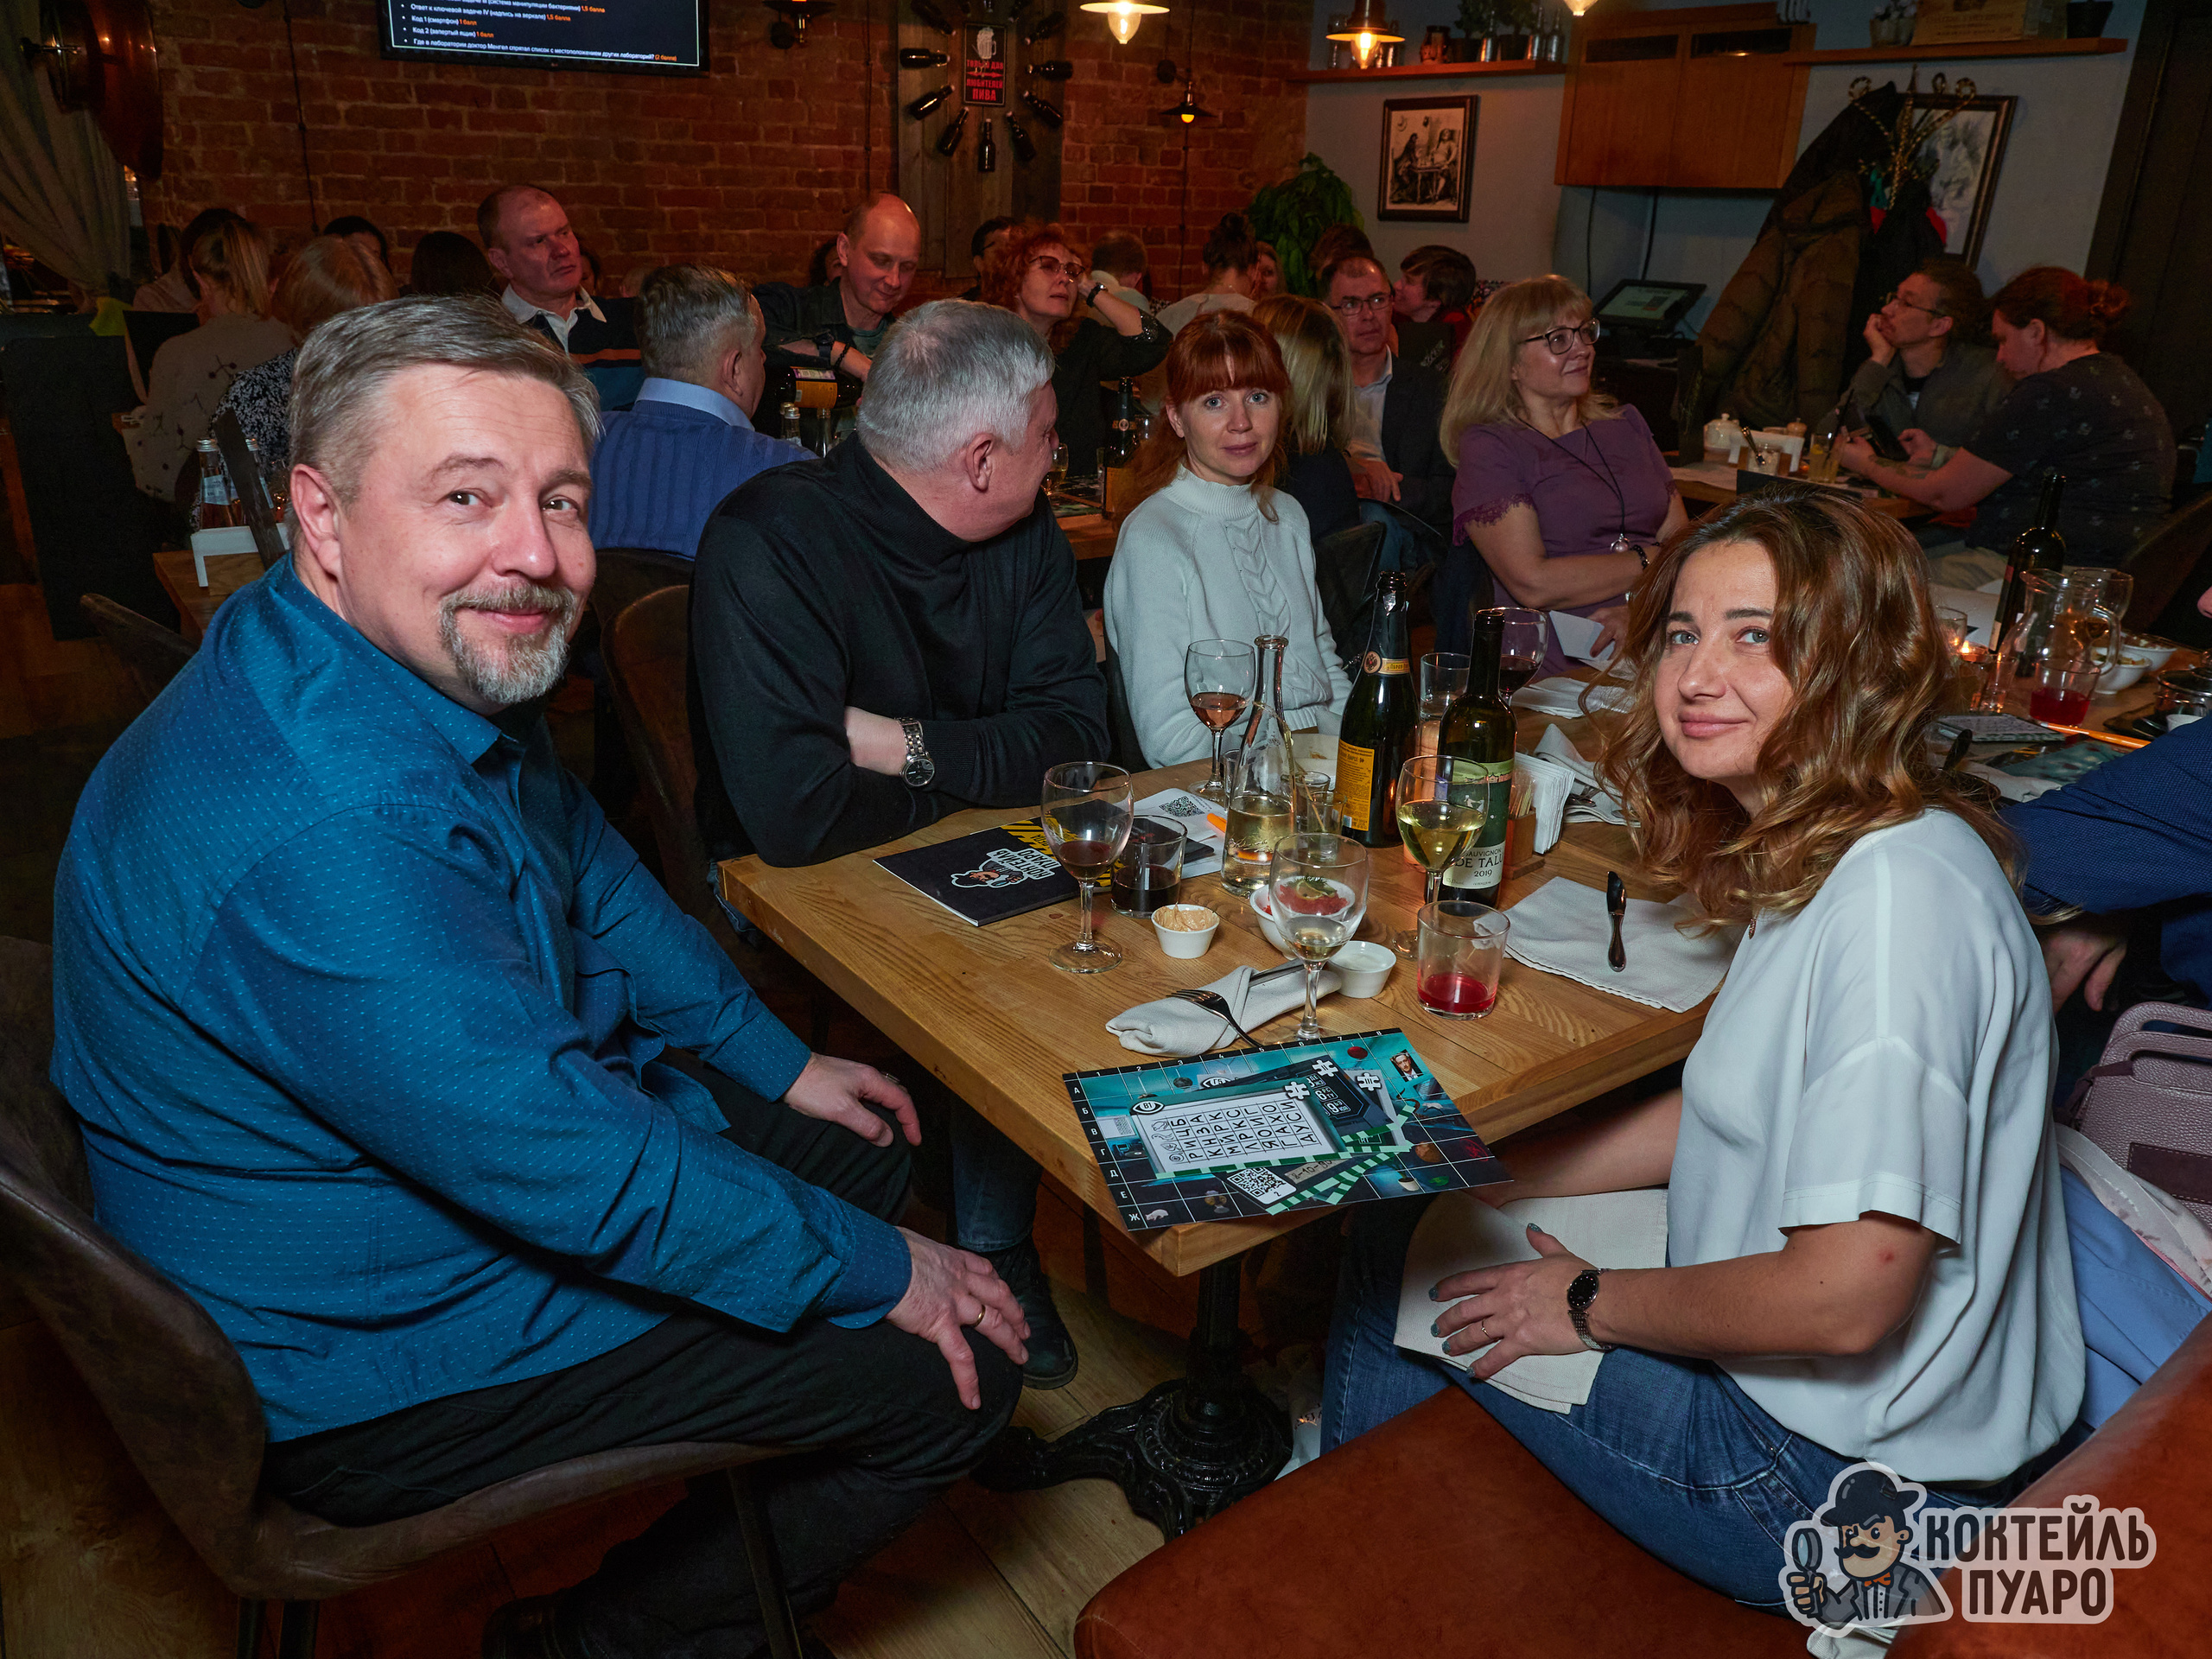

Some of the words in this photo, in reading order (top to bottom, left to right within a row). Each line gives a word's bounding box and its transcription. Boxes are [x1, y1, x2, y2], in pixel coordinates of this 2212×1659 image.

[972, 88, 996, 101] ПИВА
[993, 849, 1052, 879] КОКТЕЙЛЬ
[1017, 849, 1059, 869] ПУАРО
[1315, 1090, 1327, 1100] 6
[1327, 1103, 1339, 1113] 9
[1109, 1169, 1118, 1178] Д
[1128, 1213, 1141, 1222] Ж
